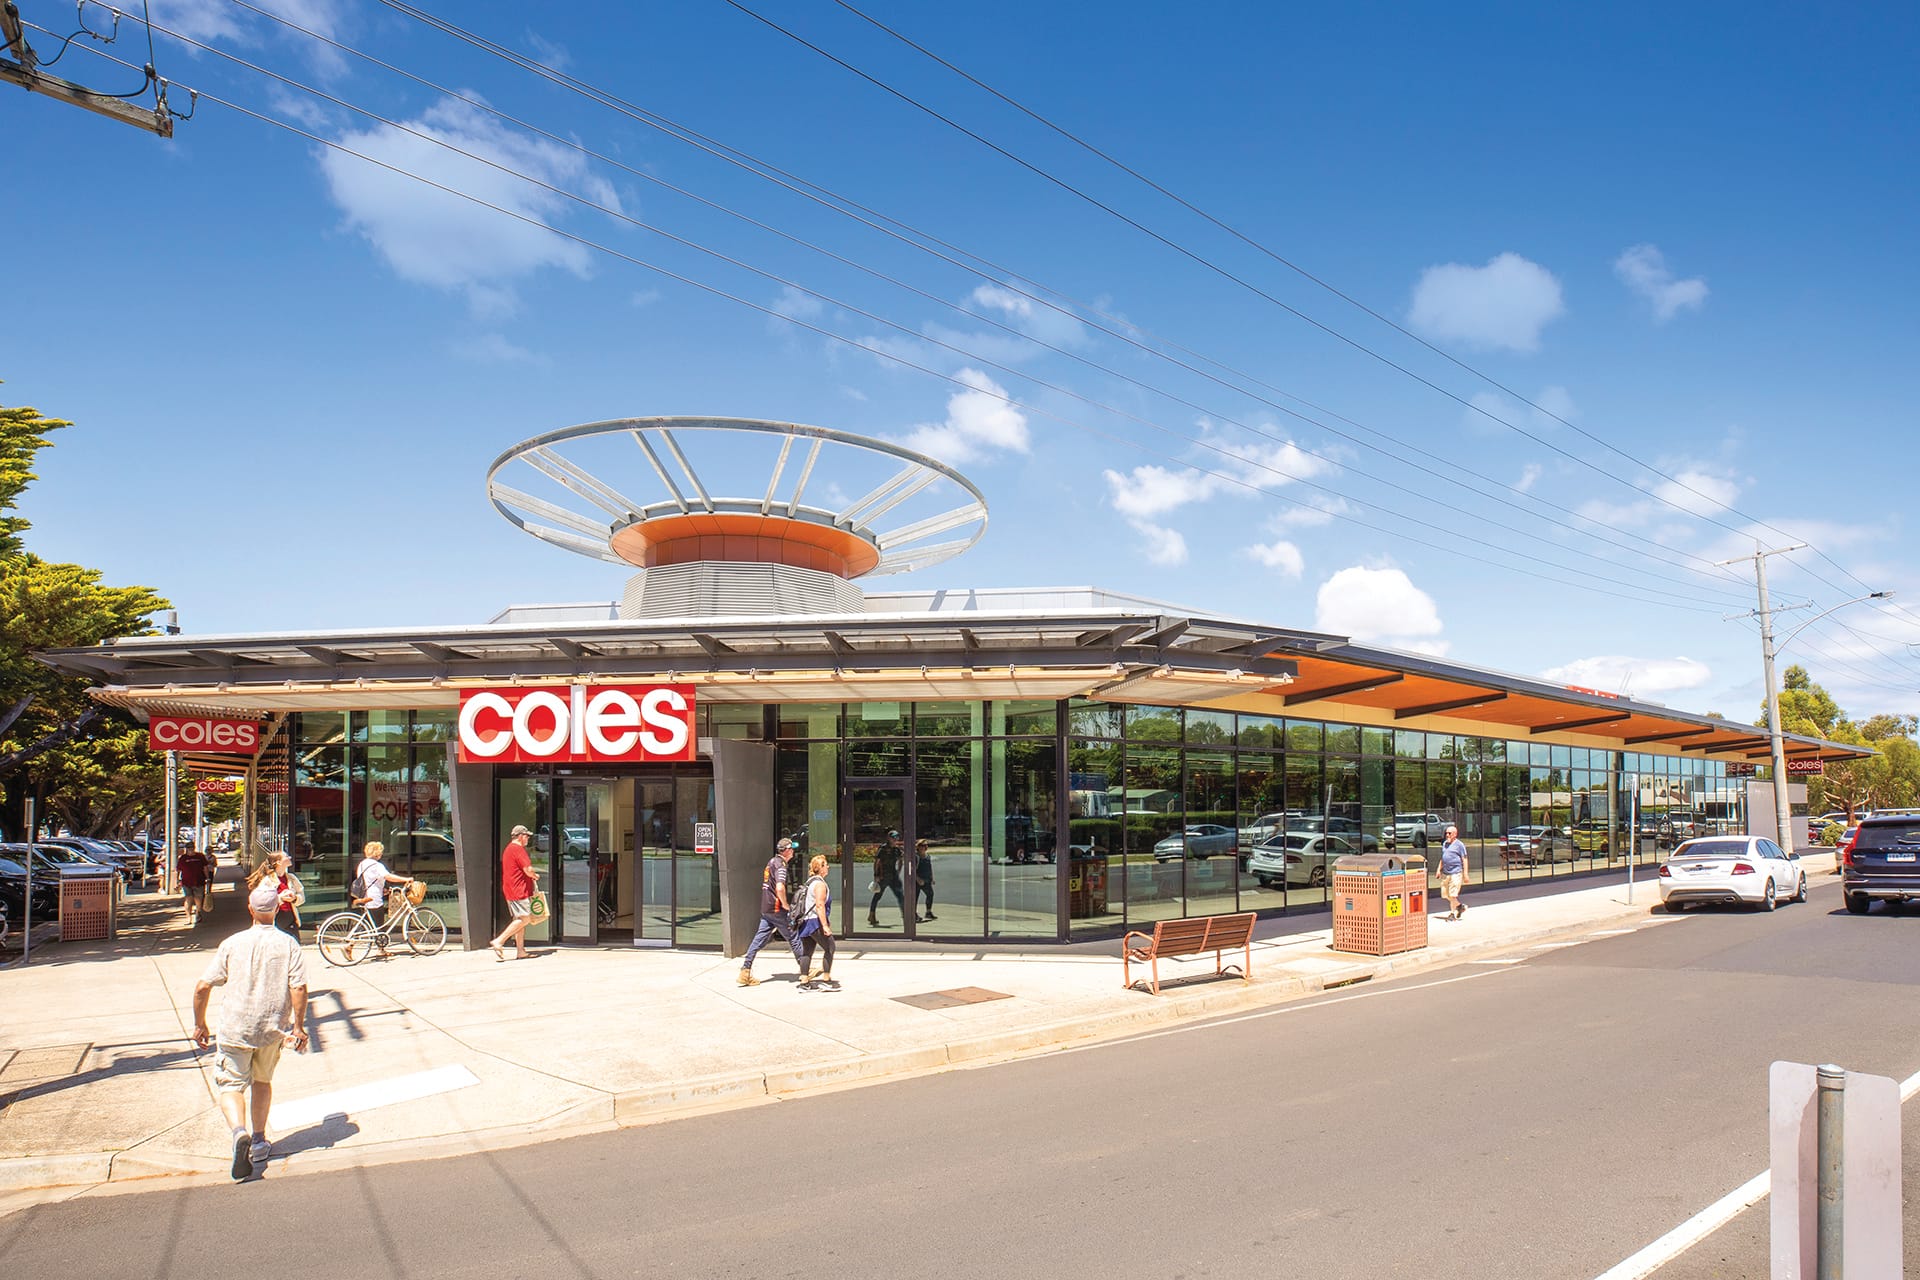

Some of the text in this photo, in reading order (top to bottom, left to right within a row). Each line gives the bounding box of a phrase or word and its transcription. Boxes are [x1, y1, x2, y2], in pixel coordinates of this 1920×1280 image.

[458, 685, 689, 757] coles
[154, 720, 255, 746] coles
[1788, 761, 1821, 769] coles
[198, 780, 235, 791] coles
